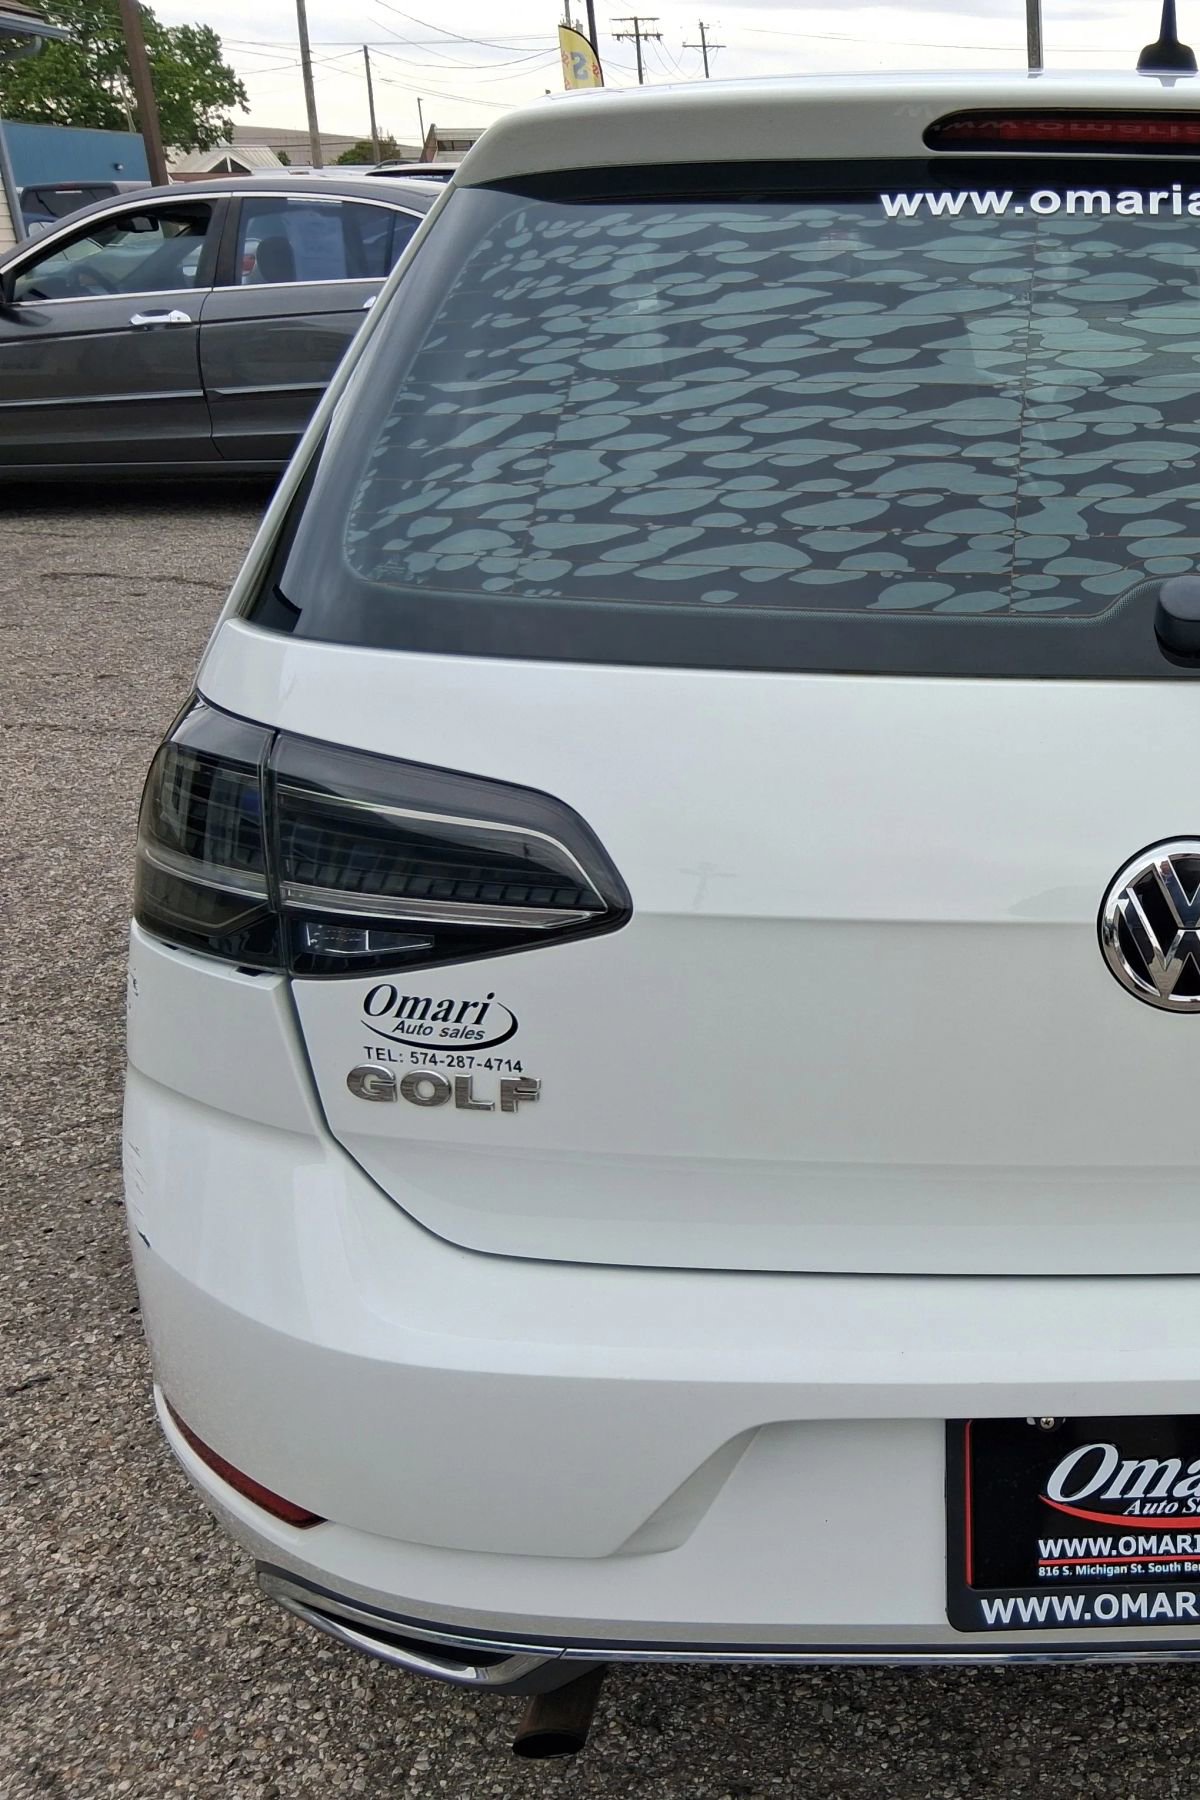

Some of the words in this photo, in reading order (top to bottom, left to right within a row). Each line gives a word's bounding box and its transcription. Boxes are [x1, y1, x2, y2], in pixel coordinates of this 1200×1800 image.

[363, 984, 496, 1026] Omari
[391, 1020, 434, 1037] Auto
[438, 1024, 486, 1041] sales
[363, 1046, 404, 1063] TEL:
[410, 1051, 524, 1073] 574-287-4714
[346, 1063, 542, 1113] GOLF
[1122, 1497, 1179, 1516] Auto
[1038, 1566, 1060, 1577] 816
[1062, 1565, 1073, 1576] S.
[1075, 1563, 1128, 1577] Michigan
[1130, 1563, 1146, 1574] St.
[1148, 1561, 1182, 1573] South
